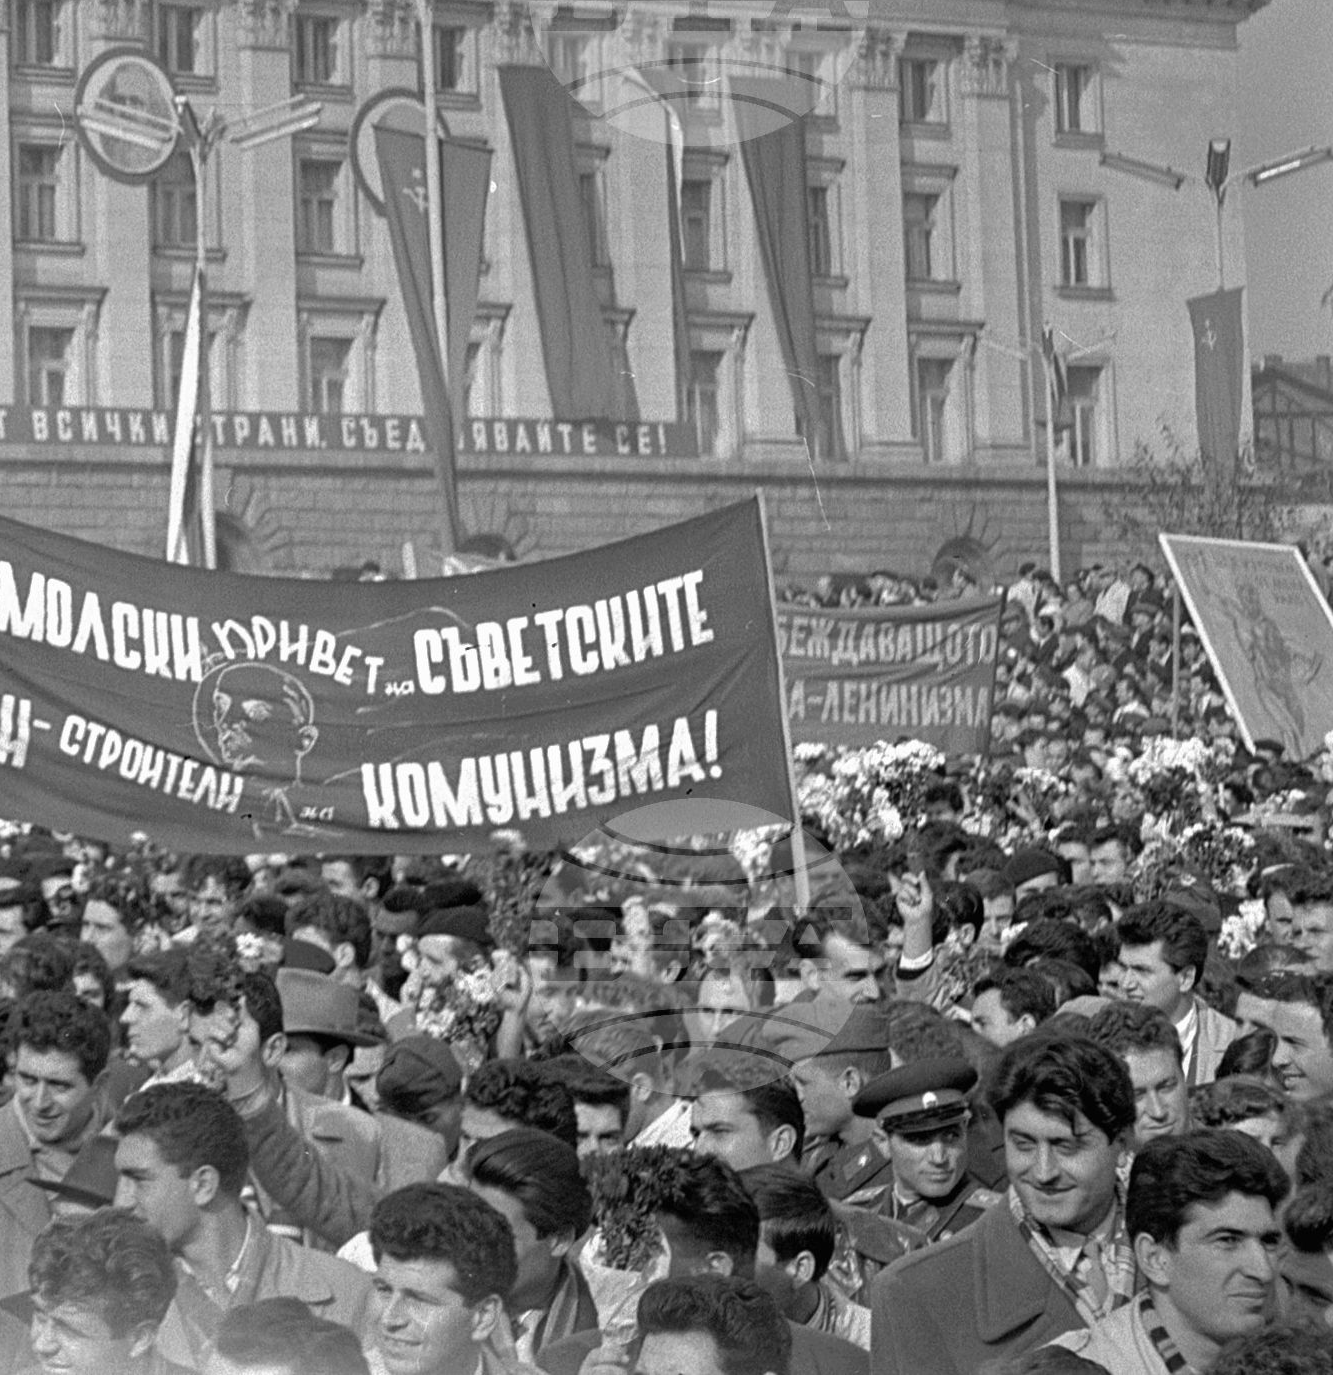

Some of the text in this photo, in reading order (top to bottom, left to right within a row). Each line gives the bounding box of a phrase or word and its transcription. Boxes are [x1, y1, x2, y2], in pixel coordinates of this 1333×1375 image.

[32, 409, 169, 444] ВСИЧКИ
[341, 417, 596, 454] СЪЕДЯВАЙТЕ
[615, 423, 667, 455] СЕ!
[211, 615, 384, 695] ПРИВЕТ
[413, 569, 714, 694] СЪВЕТСКИТЕ
[59, 714, 243, 813] СТРОИТЕЛИ
[361, 709, 722, 828] КОМУНИЗМА!
